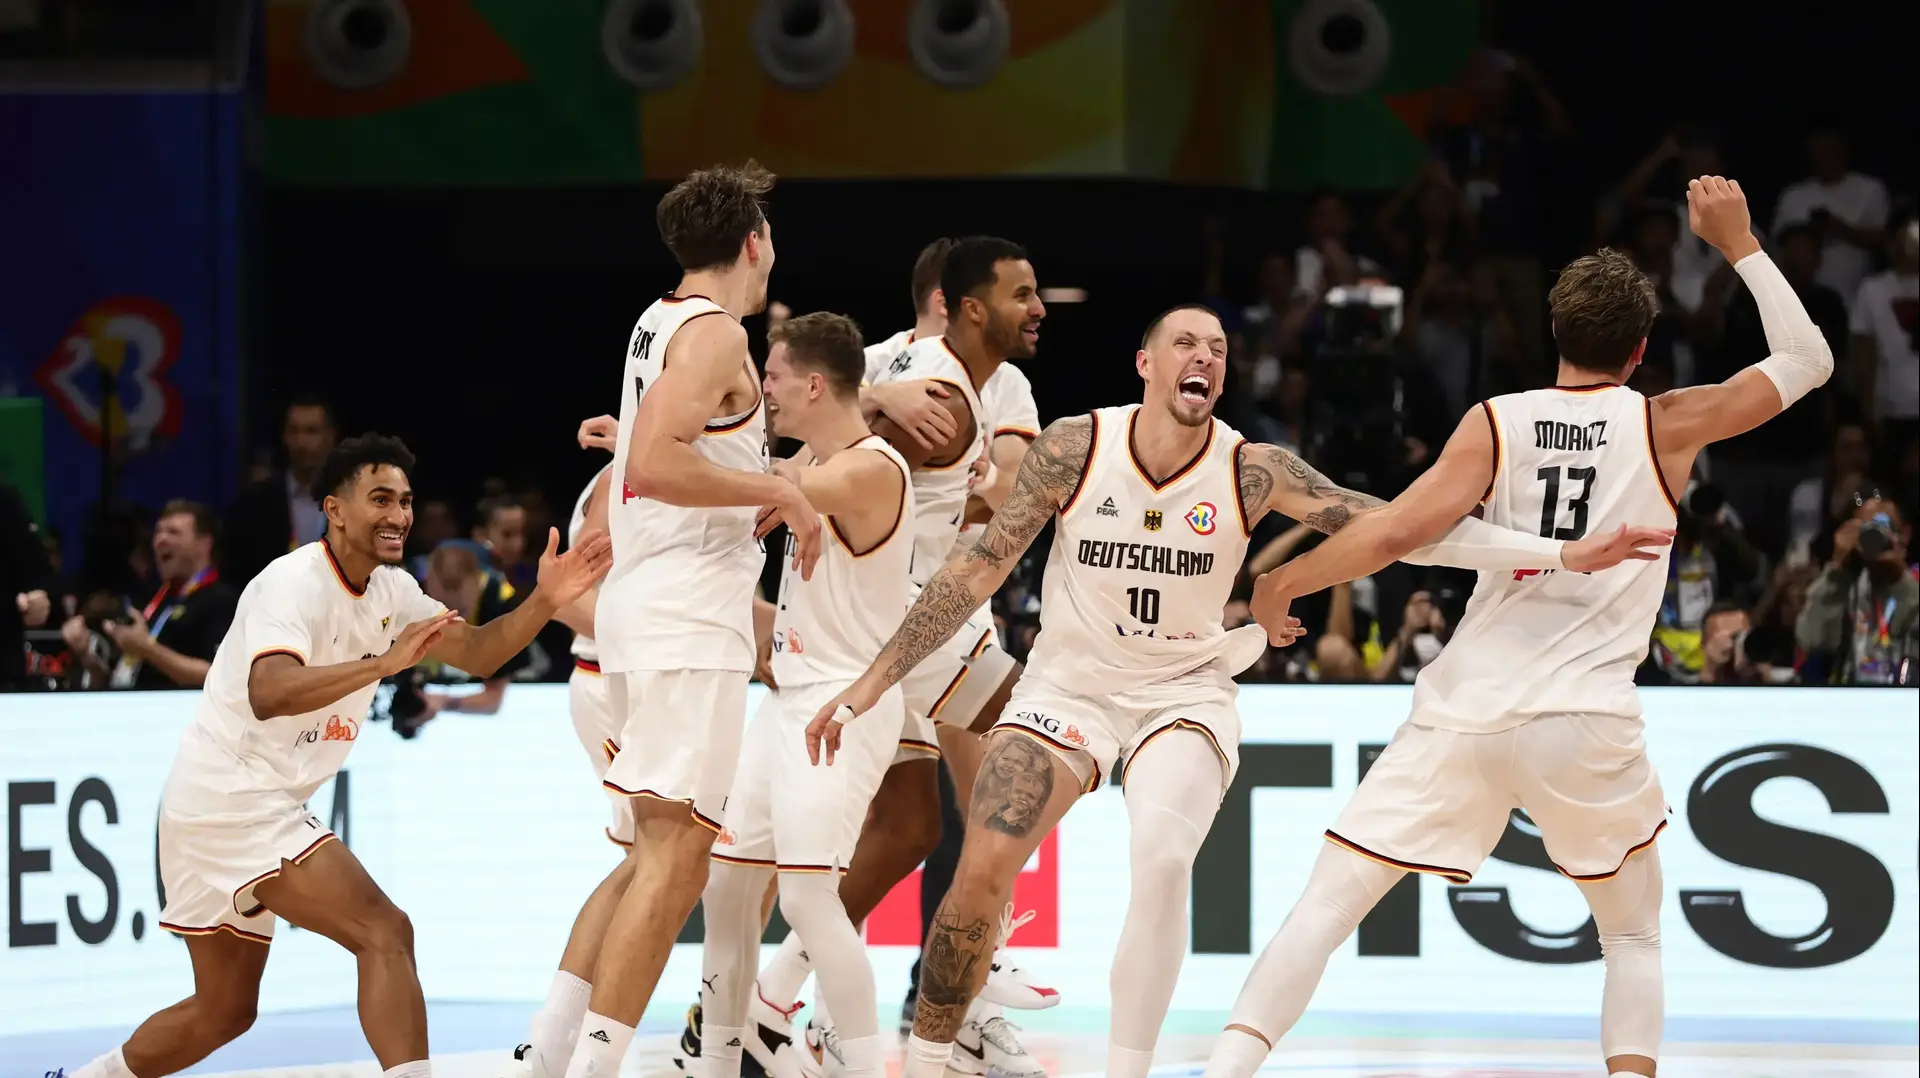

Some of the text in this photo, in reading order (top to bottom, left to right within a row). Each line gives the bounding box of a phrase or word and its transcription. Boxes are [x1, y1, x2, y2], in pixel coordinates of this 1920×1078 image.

[1096, 506, 1120, 518] PEAK
[1537, 465, 1597, 541] 13
[1077, 539, 1215, 577] DEUTSCHLAND
[1126, 586, 1161, 625] 10
